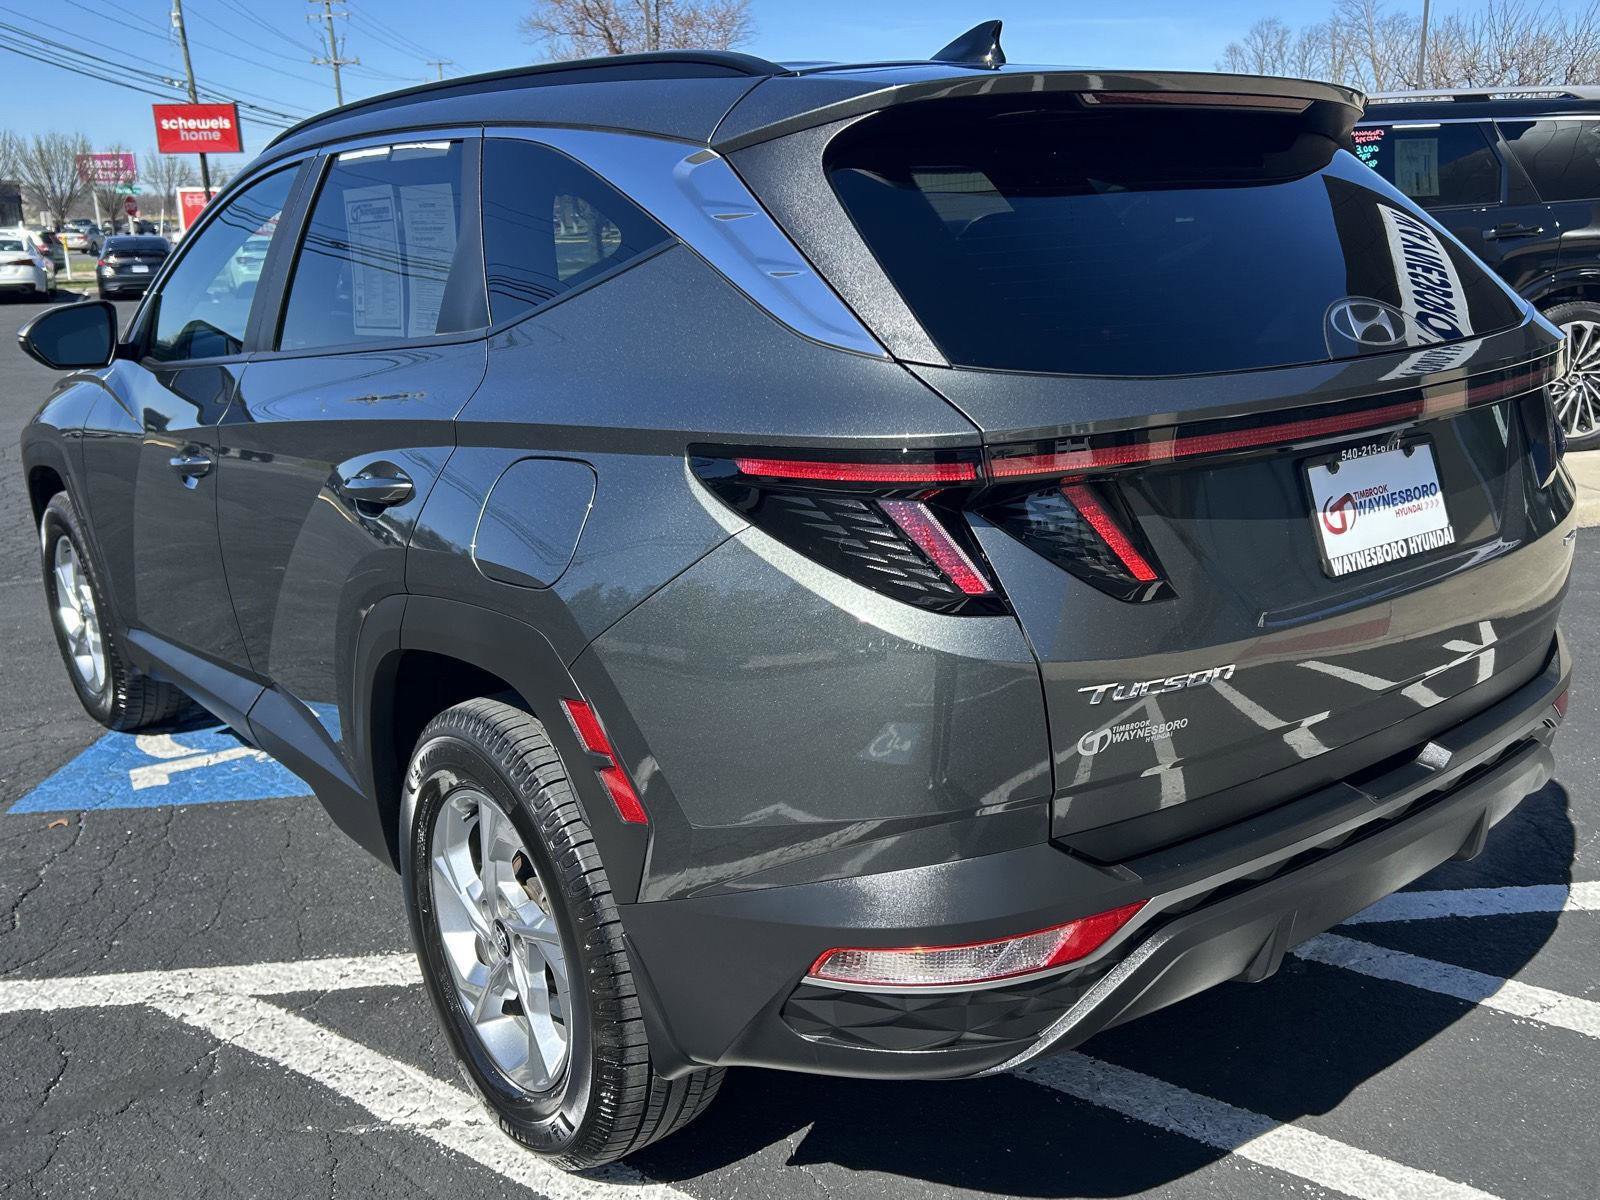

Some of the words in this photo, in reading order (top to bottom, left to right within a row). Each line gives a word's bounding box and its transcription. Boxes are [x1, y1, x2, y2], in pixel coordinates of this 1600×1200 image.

[161, 116, 231, 130] schewels
[179, 129, 222, 141] home
[1353, 484, 1388, 500] TIMBROOK
[1355, 482, 1437, 517] WAYNESBORO
[1395, 504, 1423, 518] HYUNDAI
[1330, 539, 1407, 576] WAYNESBORO
[1409, 526, 1455, 554] HYUNDAI
[1078, 664, 1236, 705] TUCSON
[1112, 720, 1151, 733] TIMBROOK
[1112, 718, 1188, 743] WAYNESBORO
[1145, 731, 1173, 743] HYUNDAI
